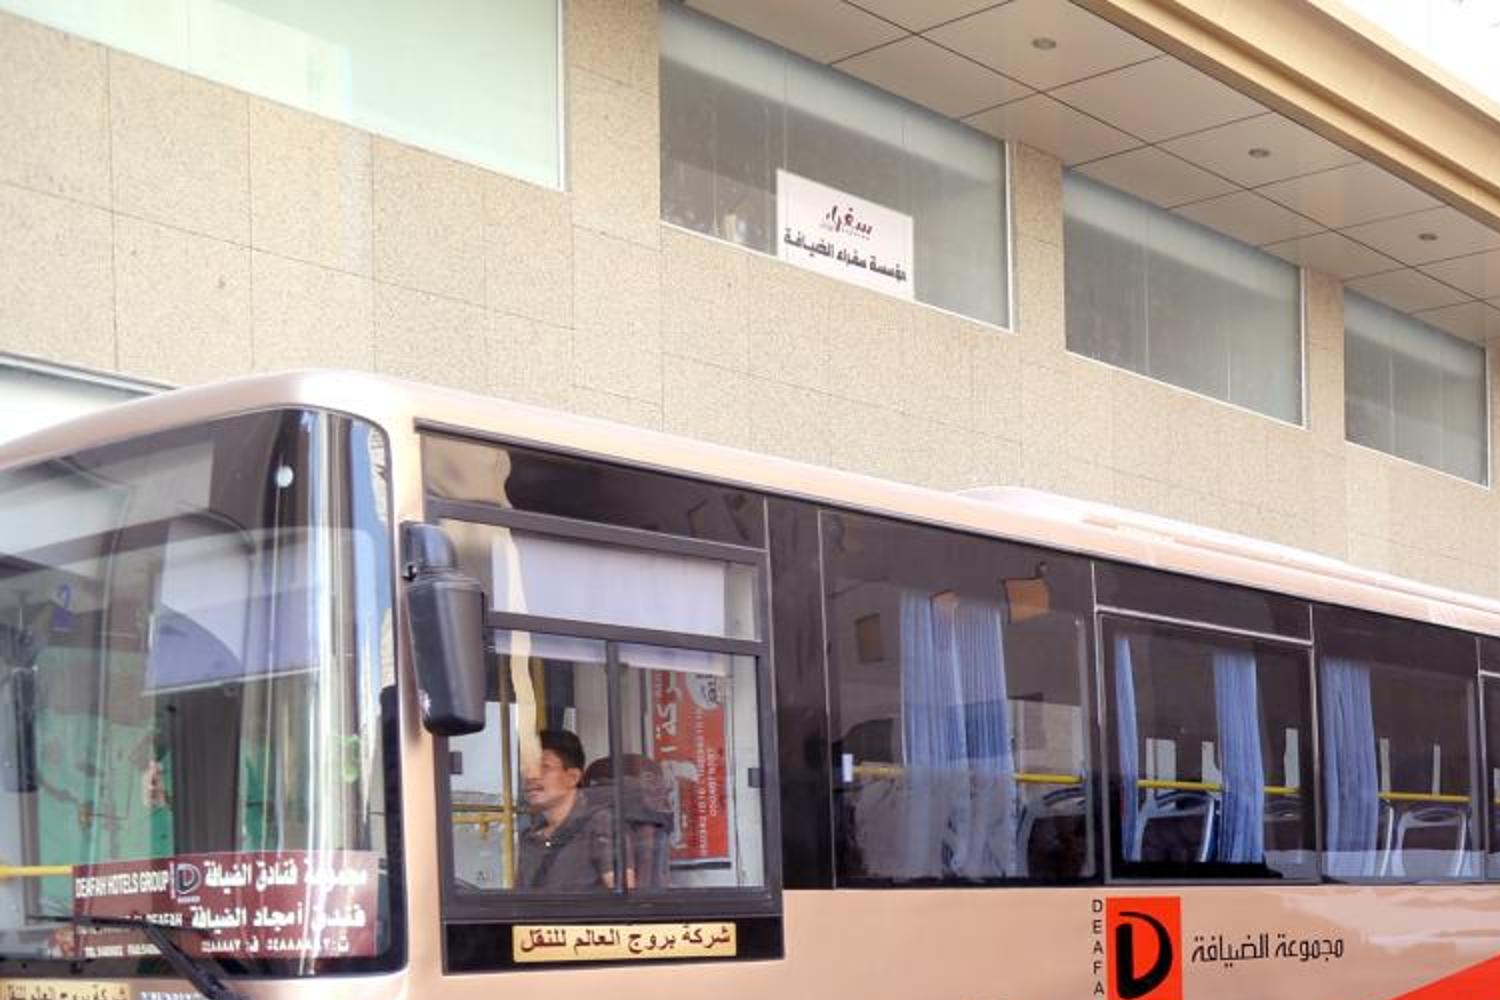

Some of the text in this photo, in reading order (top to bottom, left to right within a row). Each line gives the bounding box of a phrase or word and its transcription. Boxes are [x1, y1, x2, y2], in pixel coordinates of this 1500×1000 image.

[869, 256, 907, 283] مؤسسة
[202, 860, 252, 894] الضيافة
[256, 859, 299, 892] فنادق
[520, 923, 731, 954] شركة بروج العالم للنقل
[1191, 932, 1345, 969] مجموعة الضيافة
